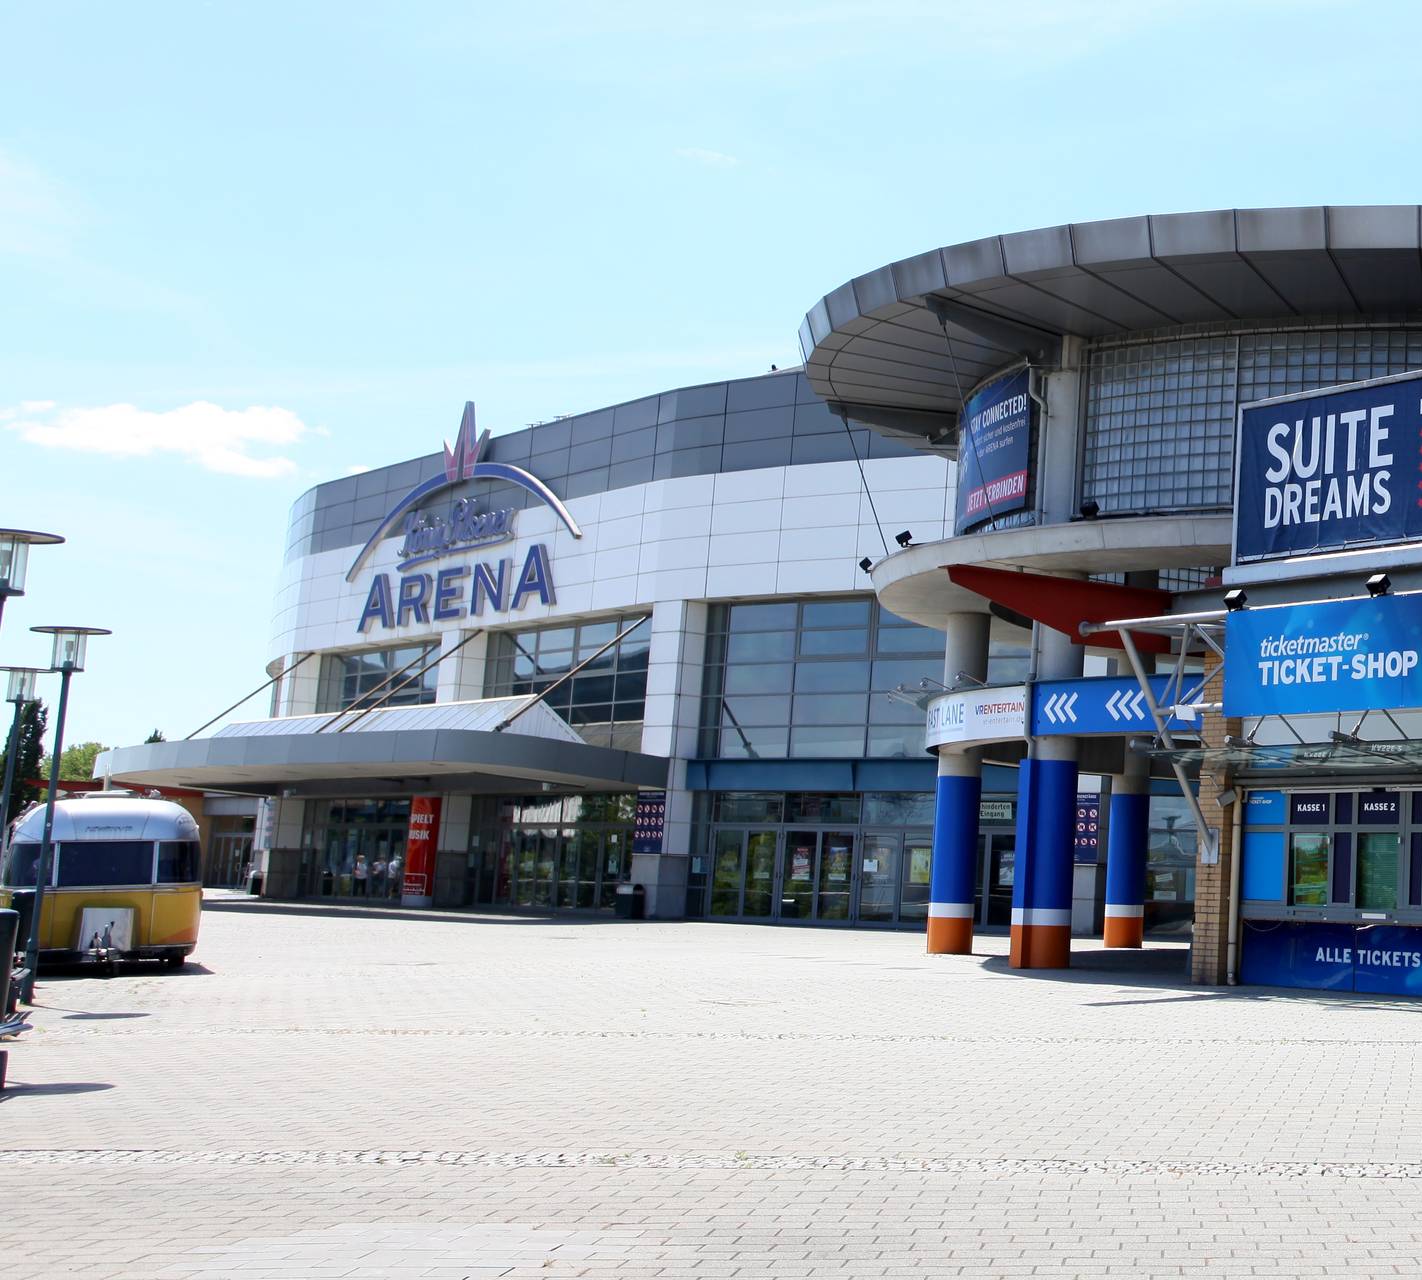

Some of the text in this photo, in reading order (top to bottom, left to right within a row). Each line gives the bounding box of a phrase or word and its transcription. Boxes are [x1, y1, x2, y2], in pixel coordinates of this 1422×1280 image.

[982, 393, 1027, 428] CONNECTED!
[1265, 404, 1395, 484] SUITE
[1264, 470, 1391, 529] DREAMS
[357, 543, 557, 633] ARENA
[1258, 650, 1418, 686] TICKET-SHOP
[941, 703, 965, 726] LANE
[1297, 803, 1326, 812] KASSE 1
[1364, 802, 1396, 812] KASSE 2
[1315, 947, 1351, 964] ALLE
[1357, 949, 1421, 968] TICKETS
